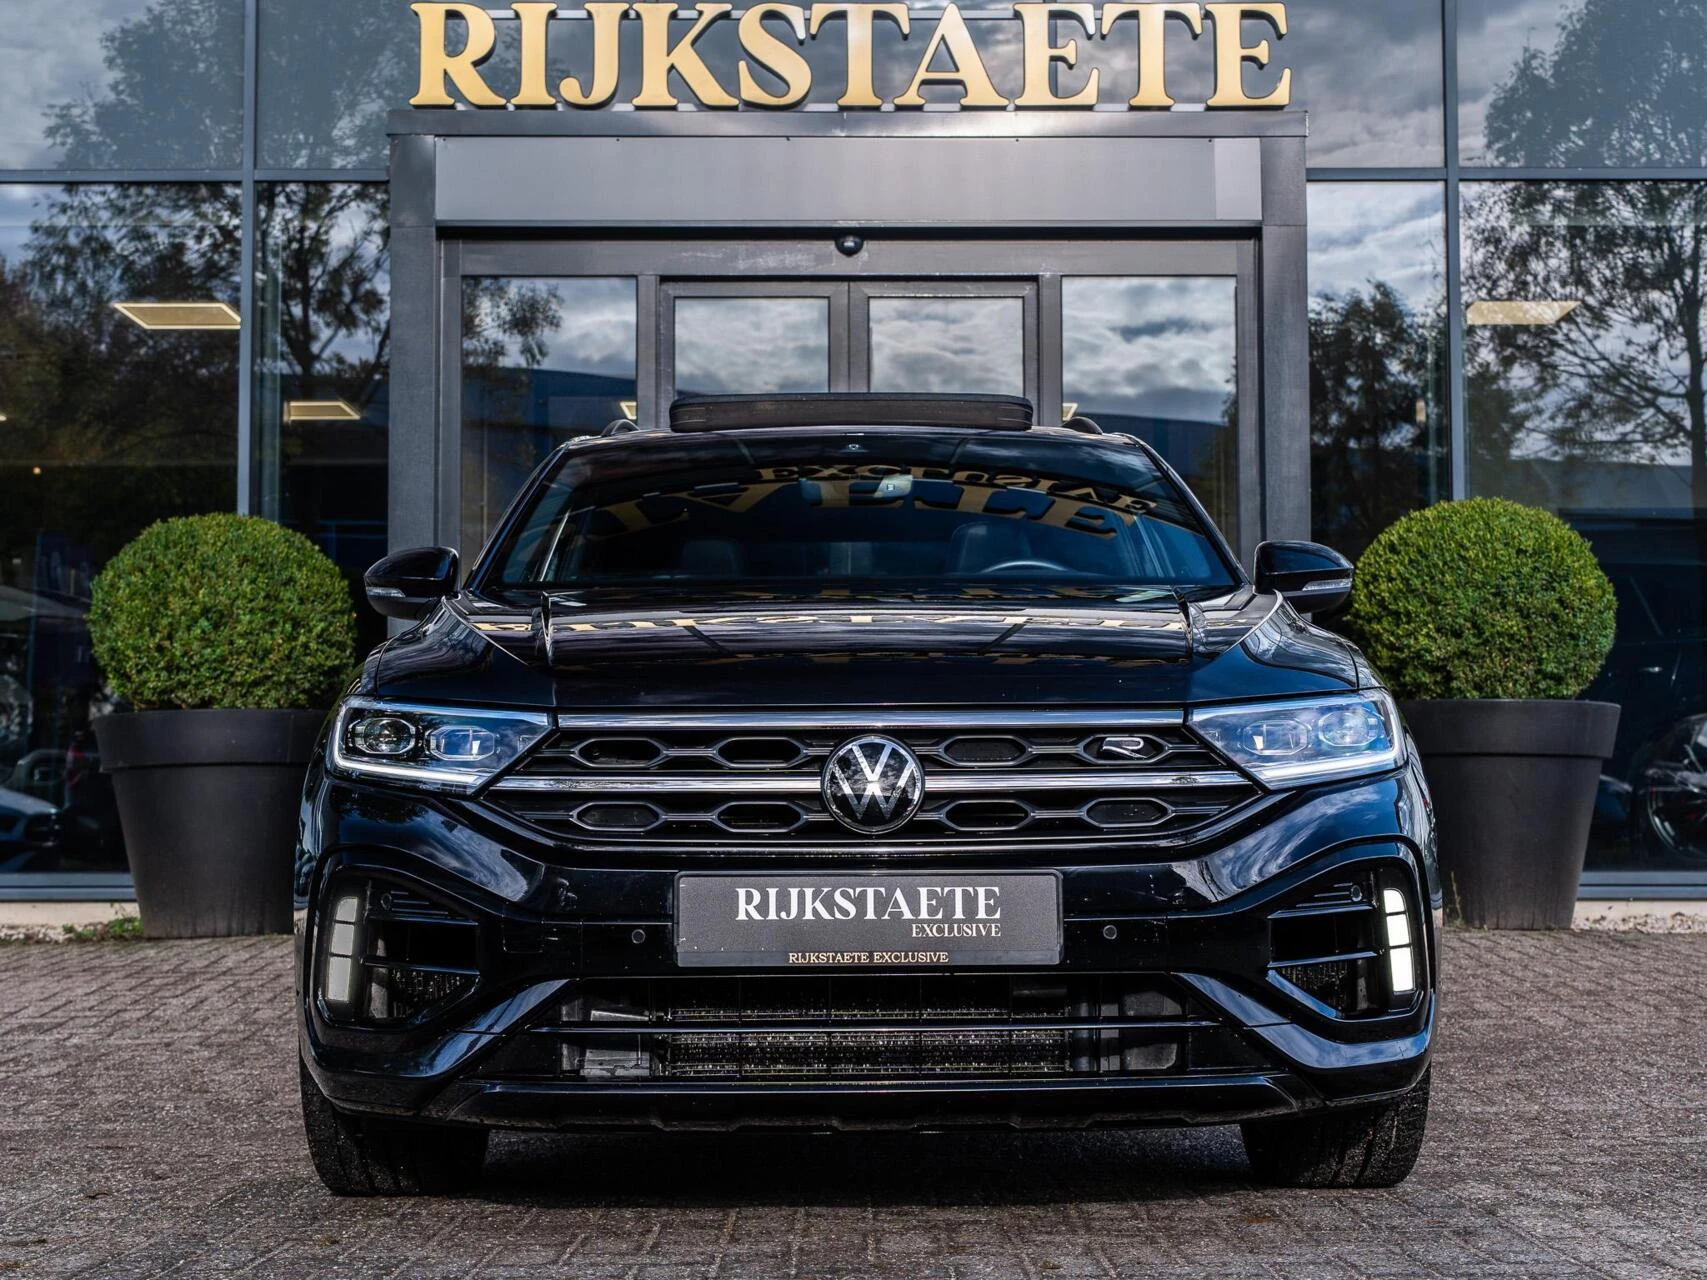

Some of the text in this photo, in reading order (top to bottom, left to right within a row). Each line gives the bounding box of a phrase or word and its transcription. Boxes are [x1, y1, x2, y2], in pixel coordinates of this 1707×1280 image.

[410, 2, 1292, 109] RIJKSTAETE
[1102, 737, 1147, 760] R
[735, 886, 1001, 921] RIJKSTAETE
[911, 923, 1001, 938] EXCLUSIVE
[788, 952, 949, 965] RIJKSTAETE EXCLUSIVE
